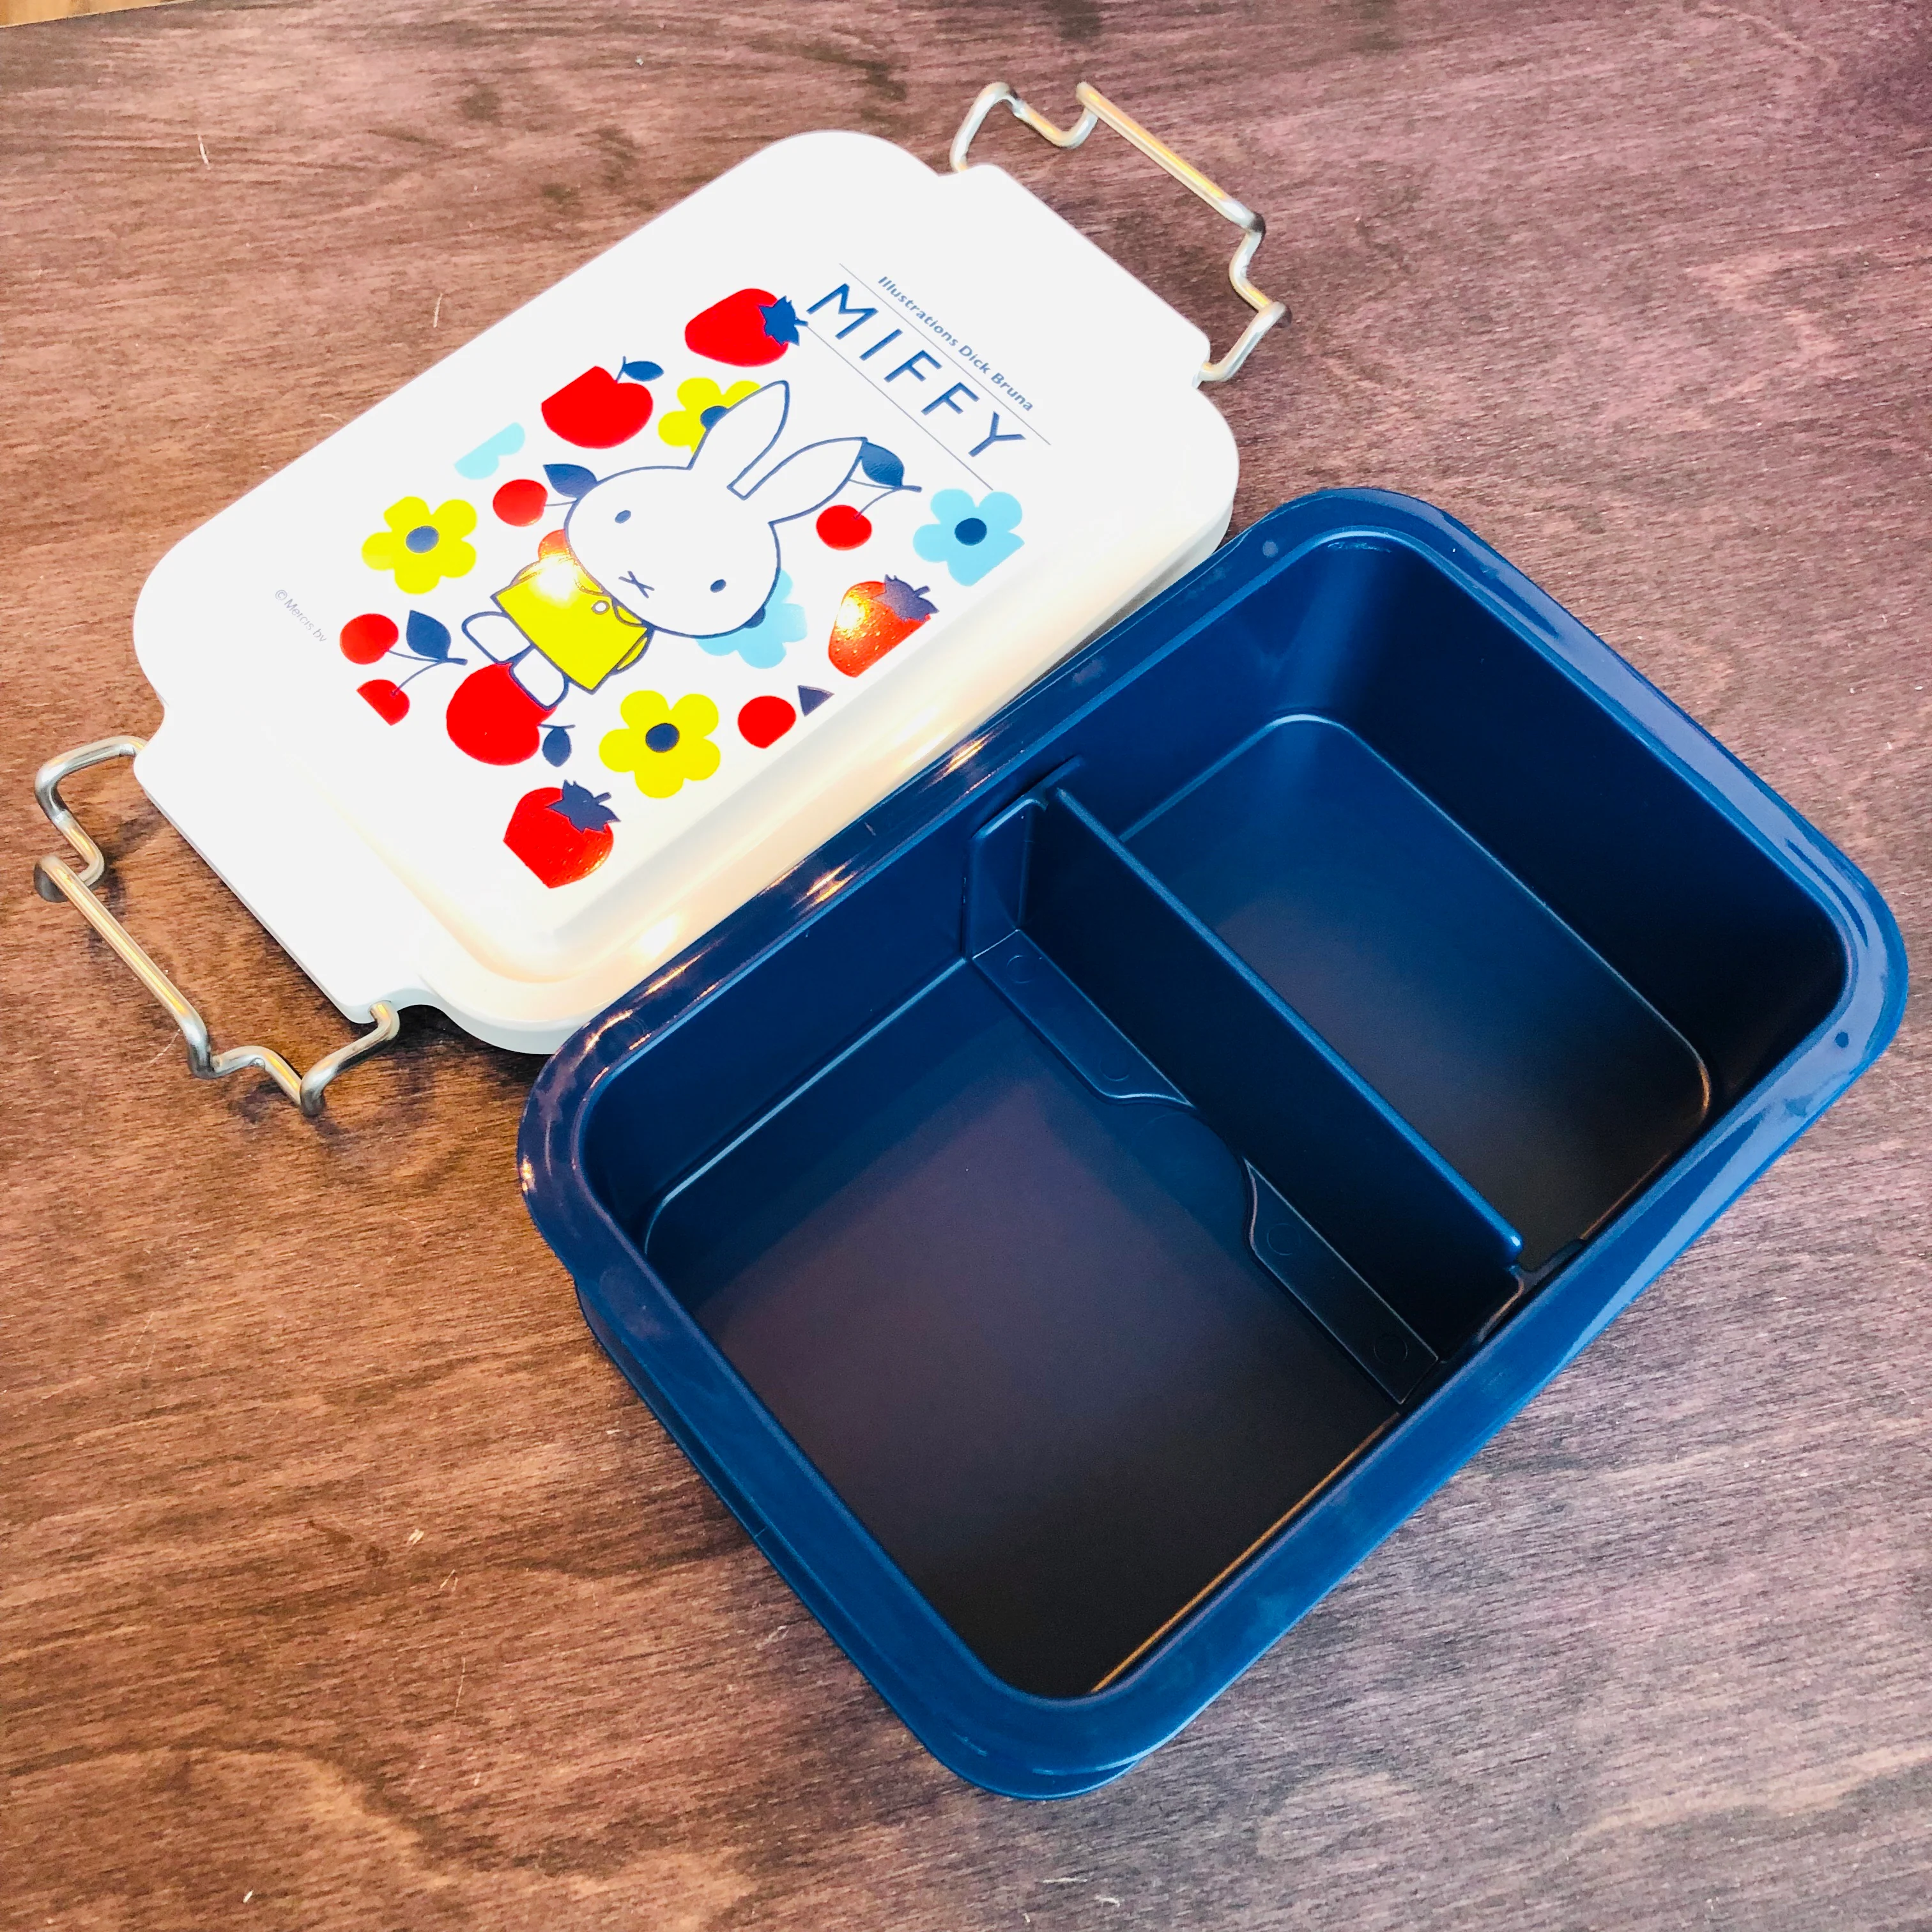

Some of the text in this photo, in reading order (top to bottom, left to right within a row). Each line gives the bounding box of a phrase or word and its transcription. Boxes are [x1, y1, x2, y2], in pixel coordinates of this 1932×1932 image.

[806, 282, 1027, 457] MIFFY
[878, 276, 1034, 411] Illustrations Dick Bruna
[312, 628, 327, 642] bv
